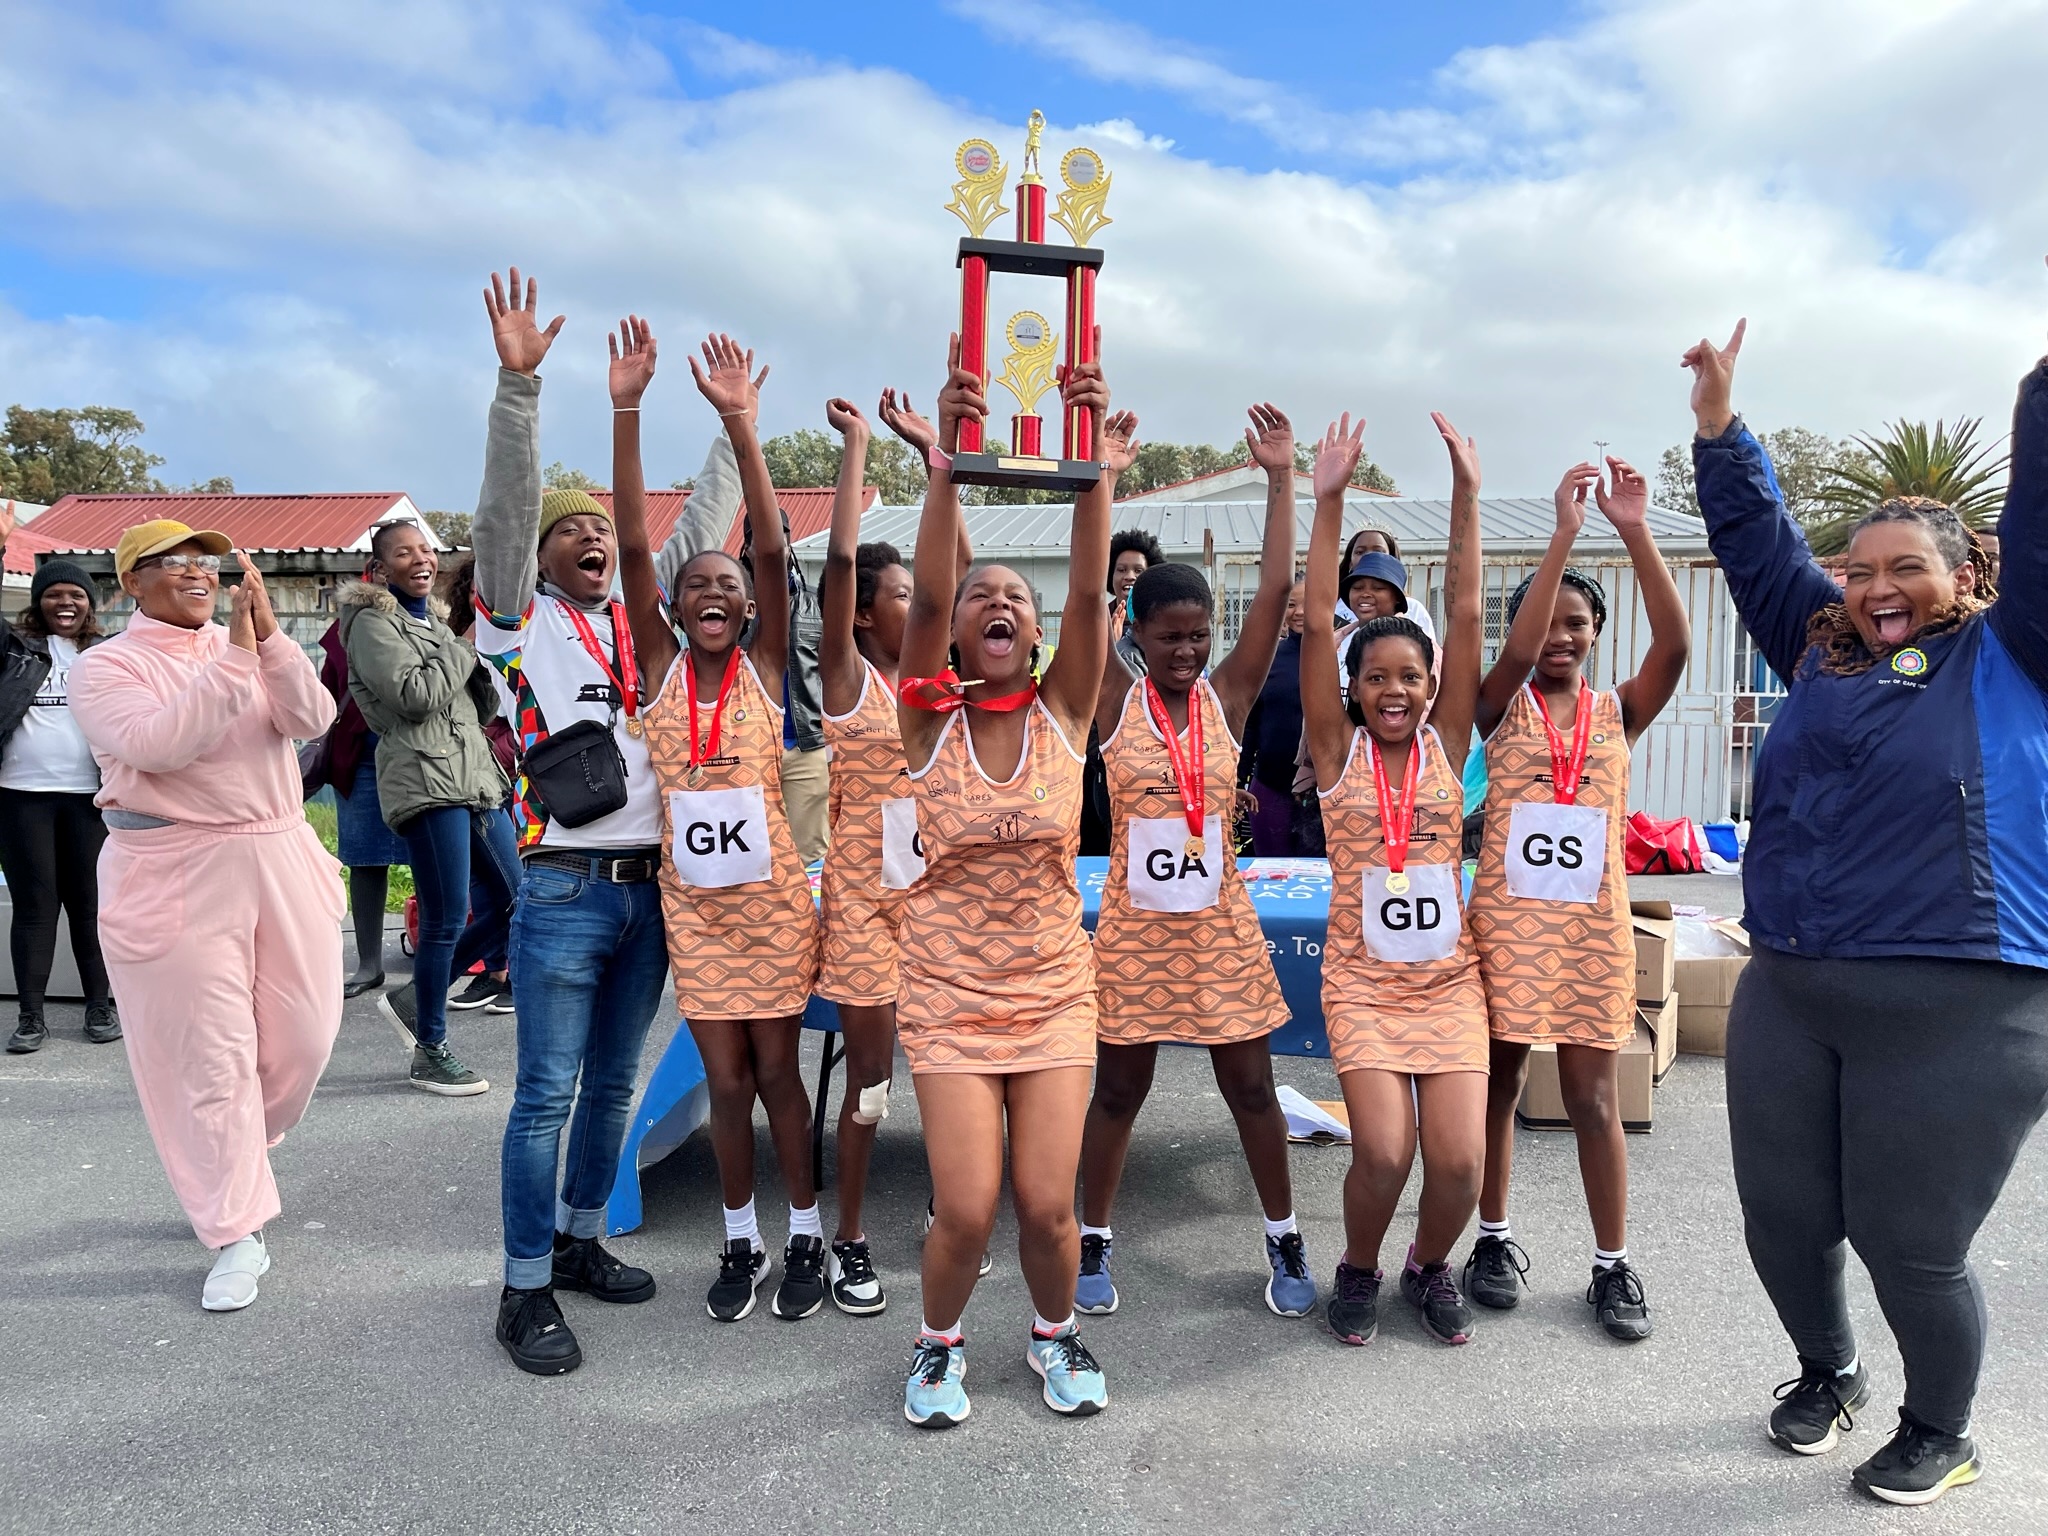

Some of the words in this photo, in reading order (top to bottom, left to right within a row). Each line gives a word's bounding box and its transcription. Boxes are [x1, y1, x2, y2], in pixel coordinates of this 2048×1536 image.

[685, 819, 751, 855] GK
[1521, 833, 1584, 870] GS
[1145, 849, 1210, 882] GA
[1380, 897, 1442, 932] GD
